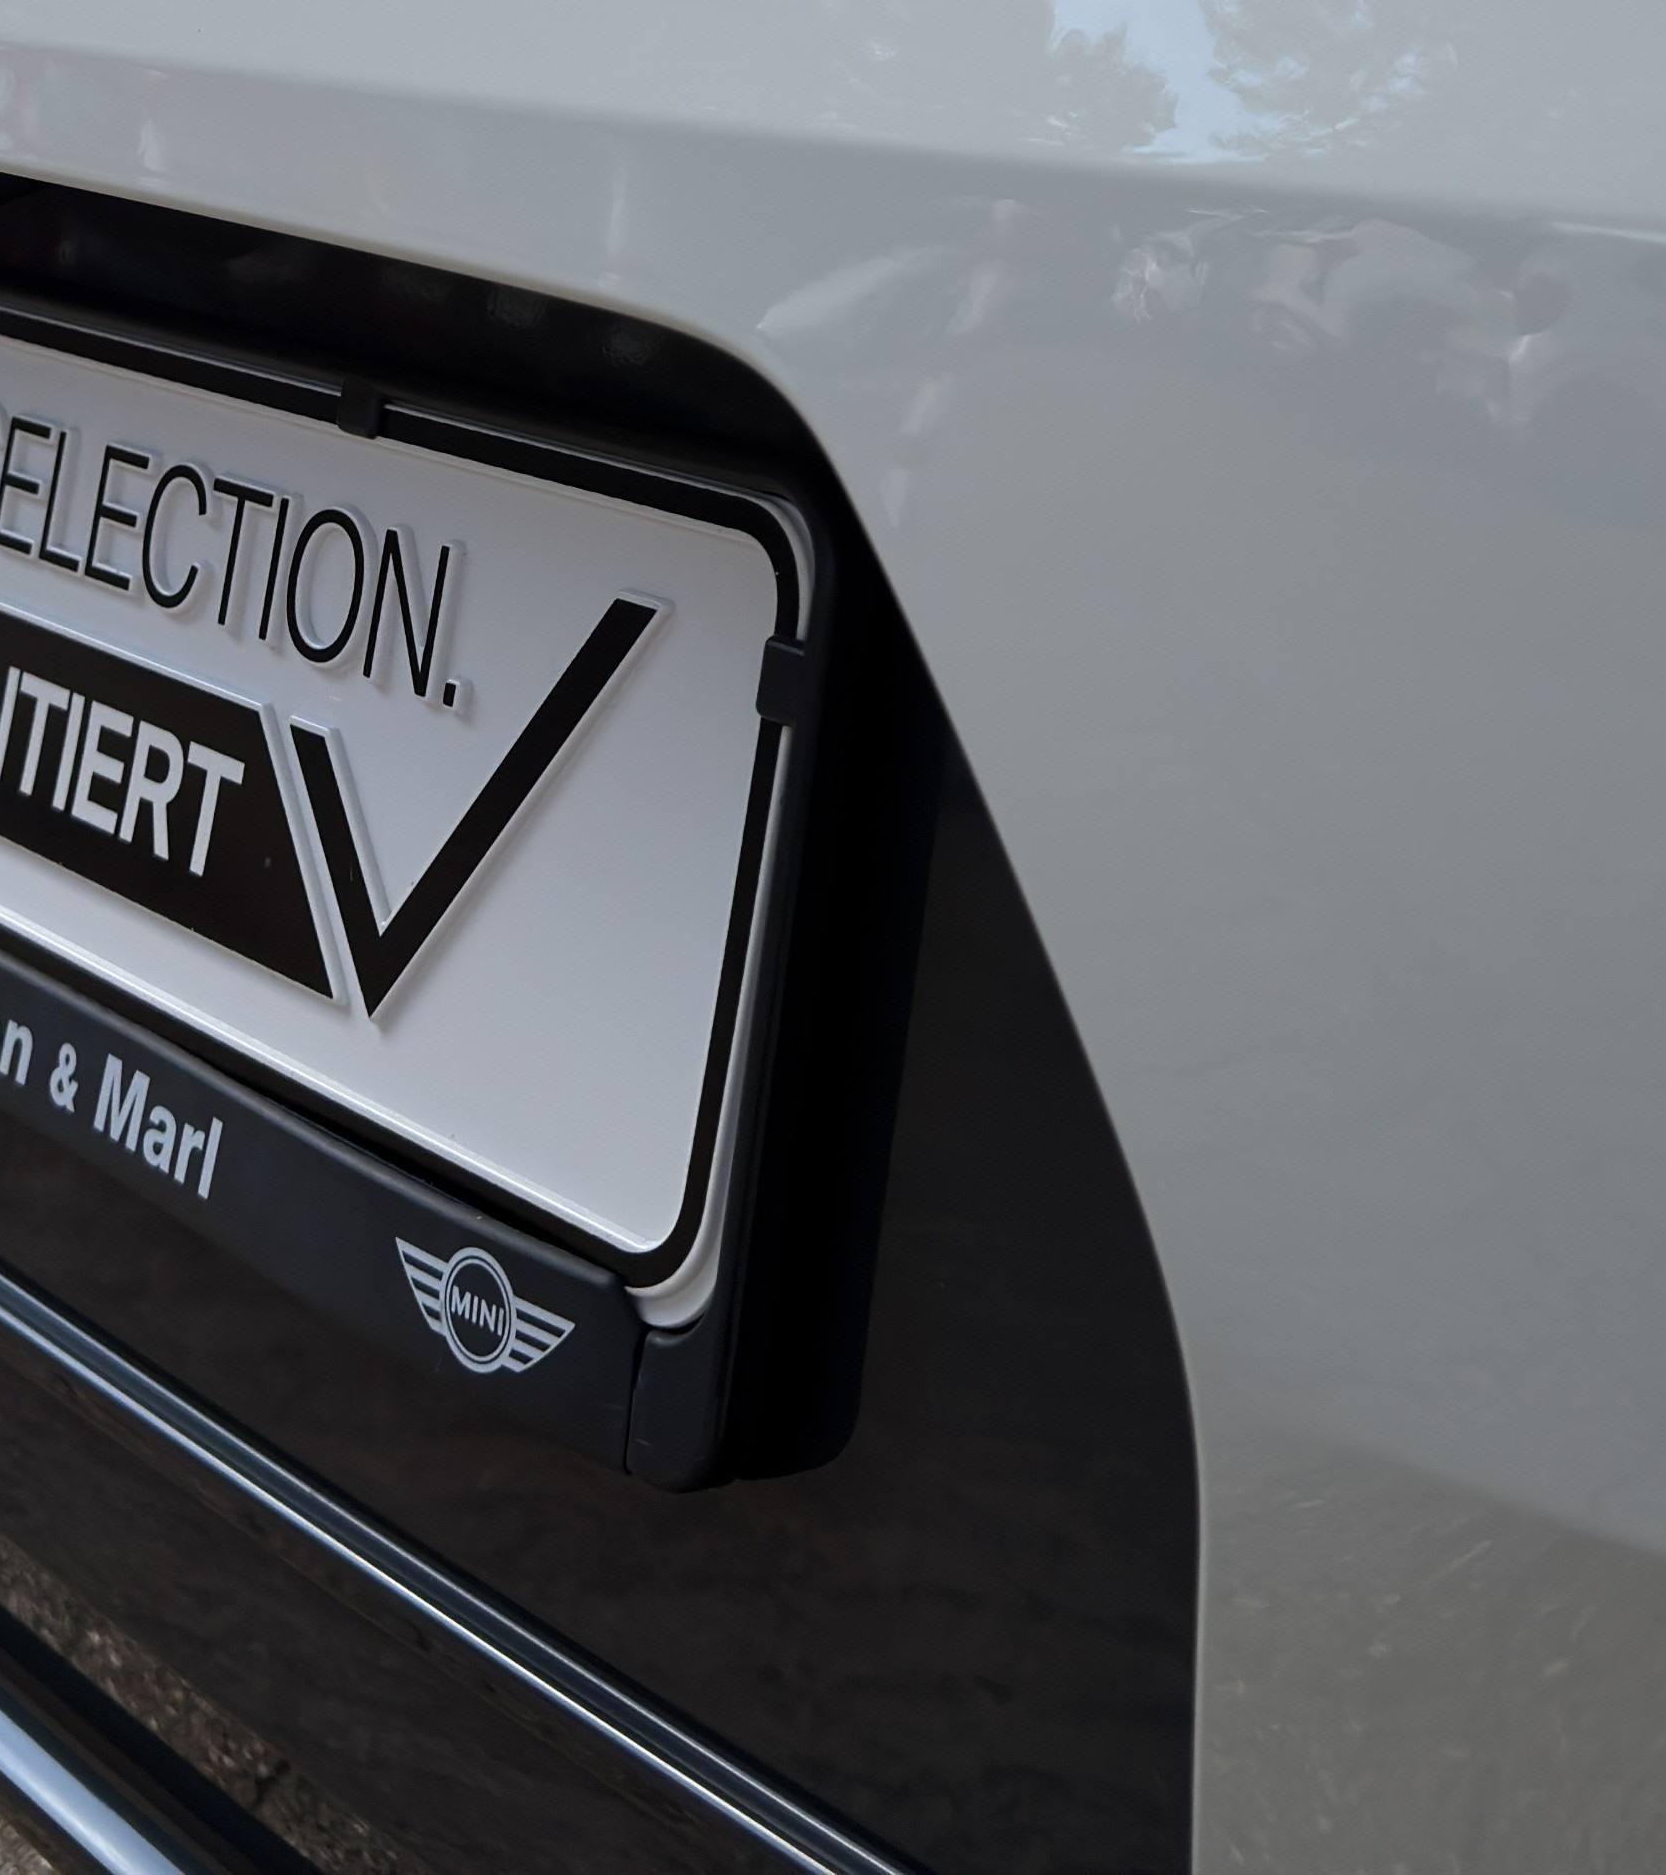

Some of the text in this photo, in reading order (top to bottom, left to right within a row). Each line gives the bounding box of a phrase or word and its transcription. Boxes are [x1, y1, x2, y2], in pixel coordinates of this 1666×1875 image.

[49, 1042, 80, 1114] &
[93, 1052, 225, 1201] Marl
[450, 1284, 505, 1338] MINI
